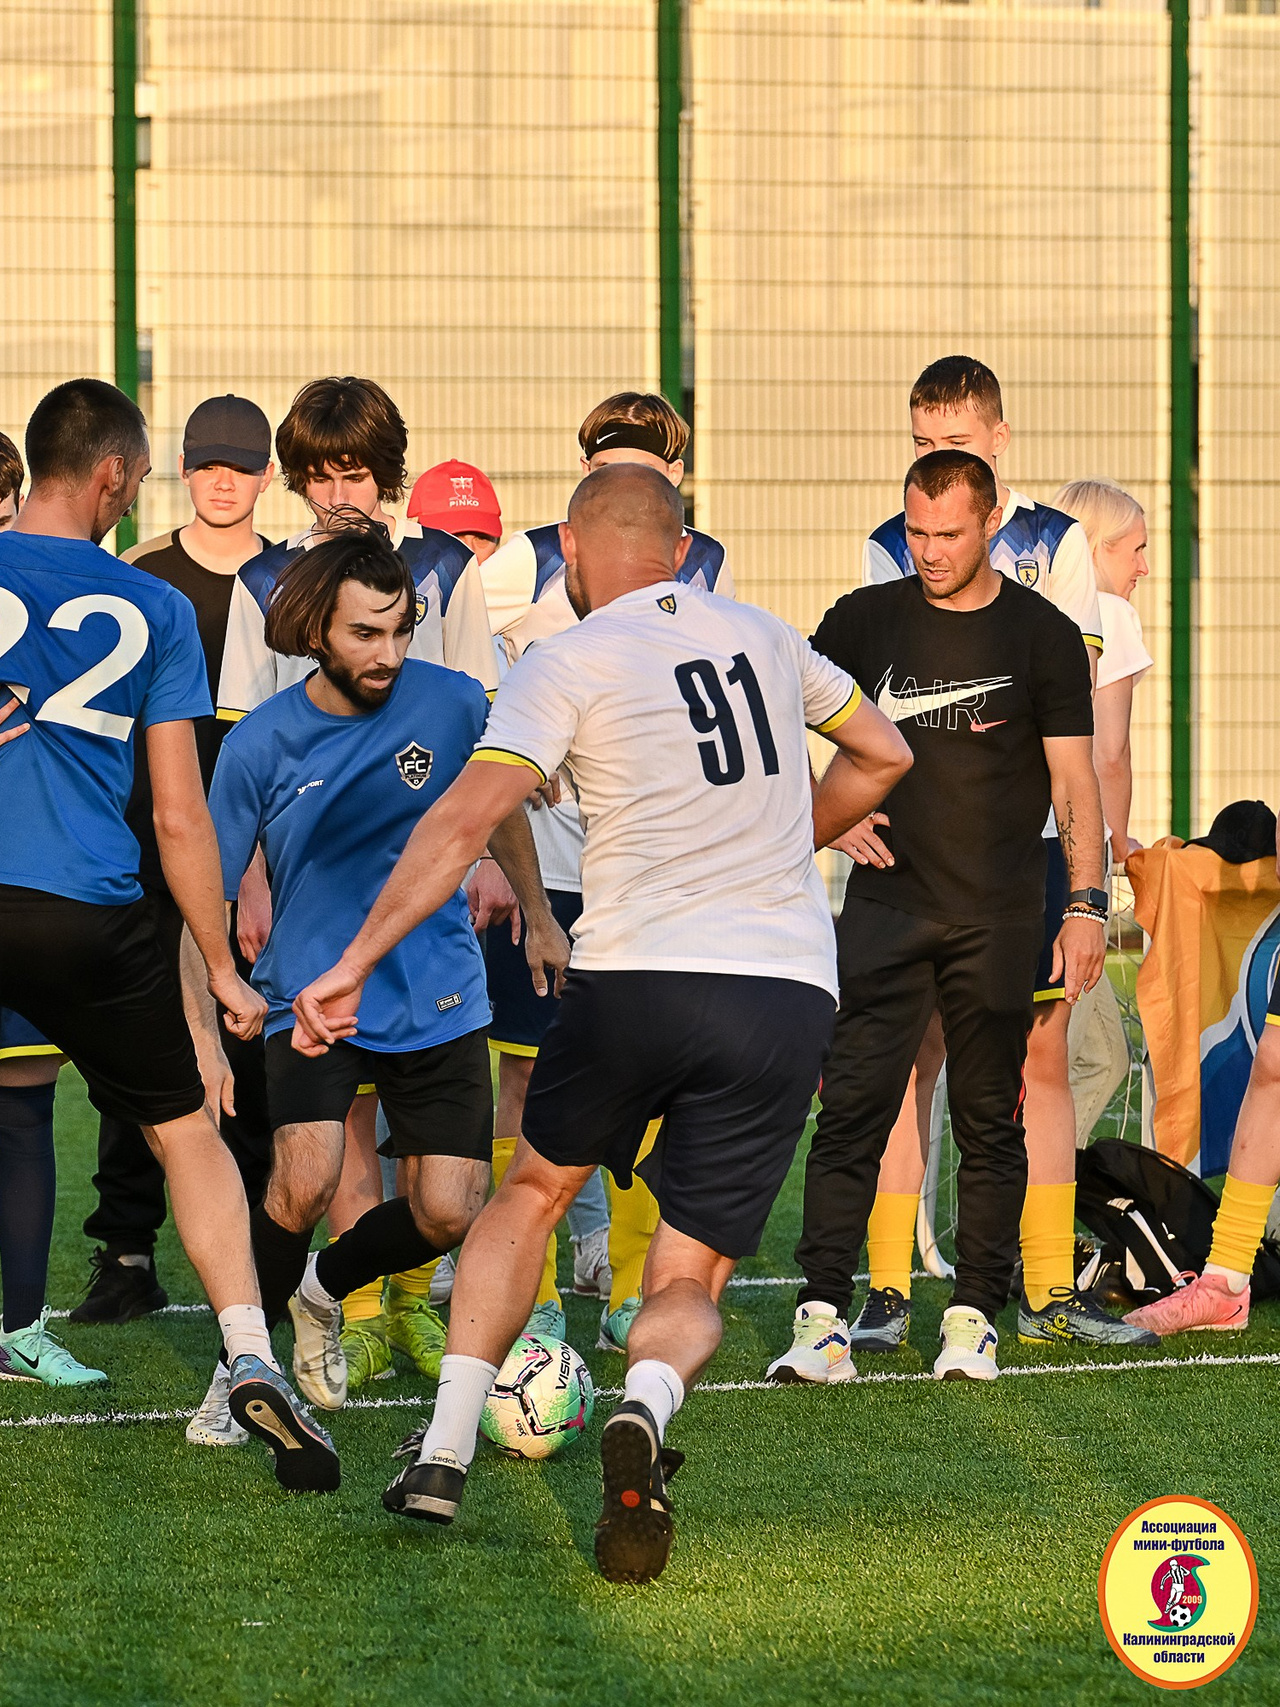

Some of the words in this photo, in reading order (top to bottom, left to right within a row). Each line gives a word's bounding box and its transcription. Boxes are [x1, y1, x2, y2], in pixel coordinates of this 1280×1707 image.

[674, 652, 780, 786] 91
[890, 677, 986, 732] AIR
[404, 760, 427, 774] FC
[555, 1343, 571, 1389] VISION
[430, 1455, 457, 1465] adidas
